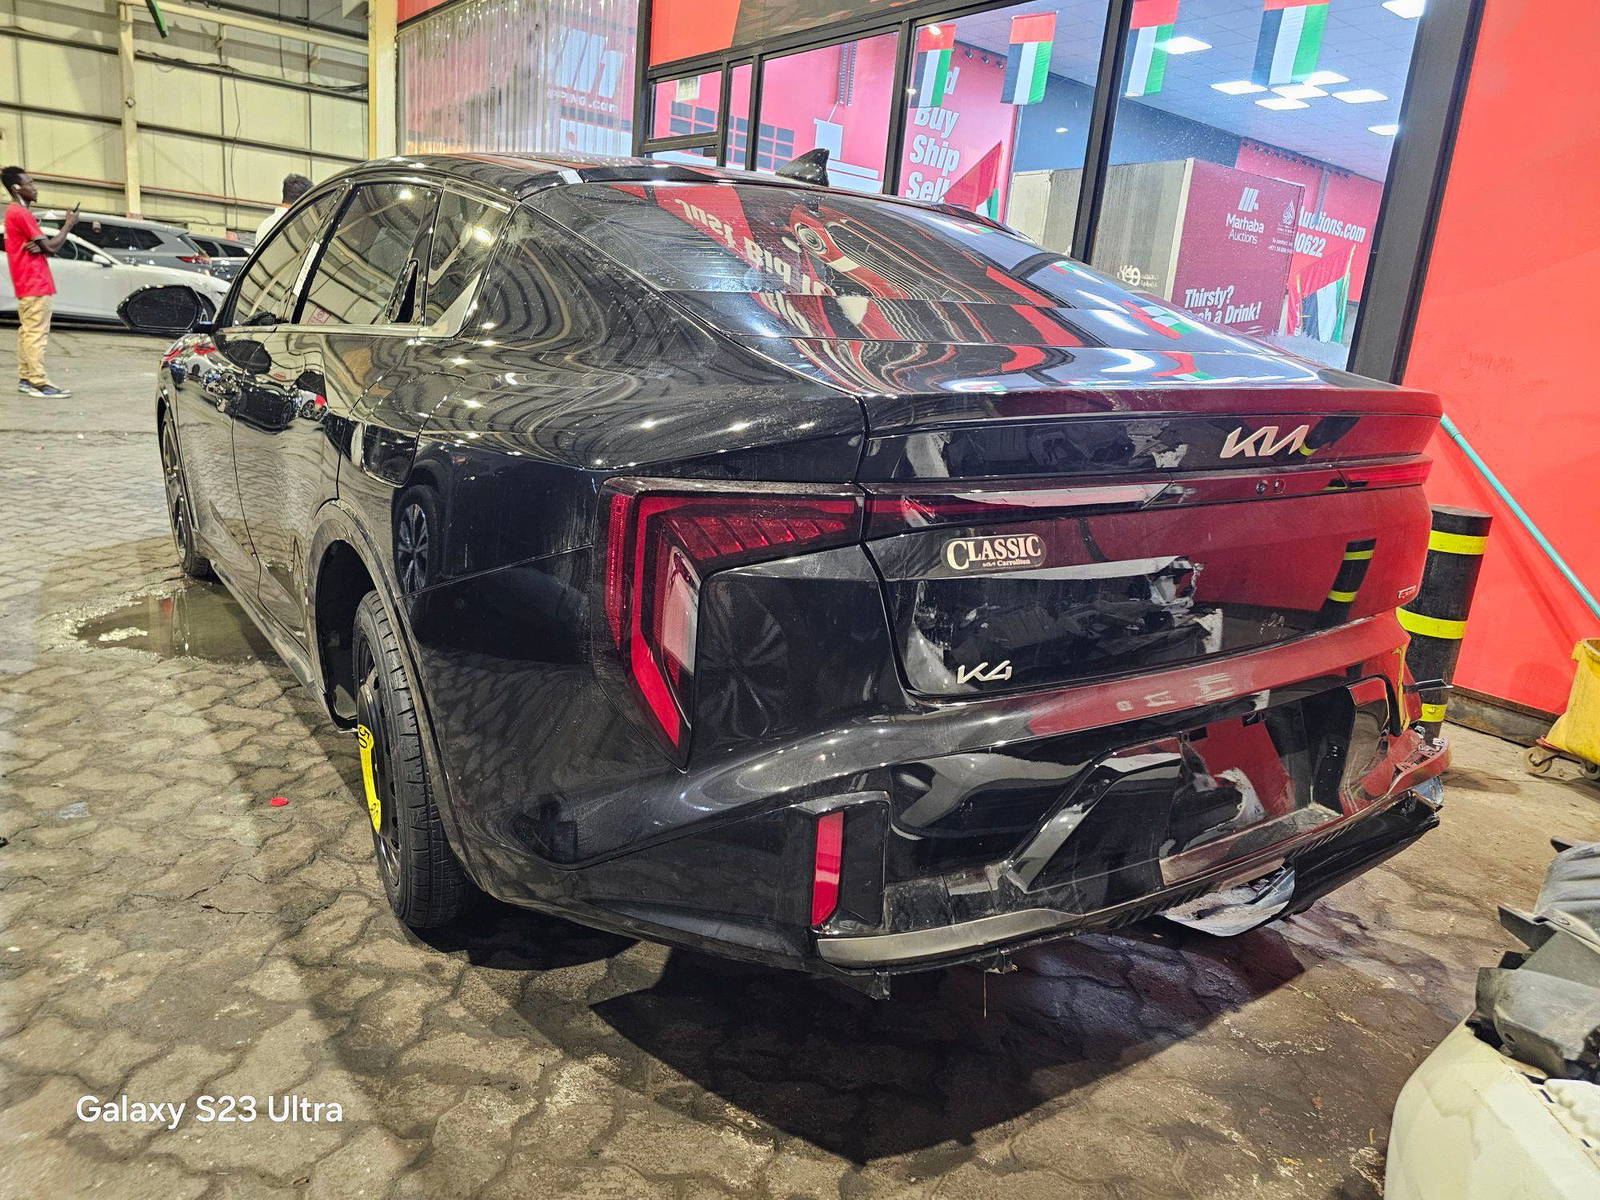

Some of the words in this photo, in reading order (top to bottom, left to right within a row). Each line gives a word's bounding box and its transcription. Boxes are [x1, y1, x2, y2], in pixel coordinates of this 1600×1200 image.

[914, 107, 960, 139] Buy
[909, 134, 960, 177] Ship
[1225, 213, 1265, 234] Marhaba
[1228, 229, 1259, 245] Auctions
[1184, 285, 1235, 309] Thirsty?
[1224, 301, 1262, 325] Drink!
[1220, 424, 1310, 459] KIA
[946, 535, 1042, 571] CLASSIC
[957, 659, 1013, 684] K4
